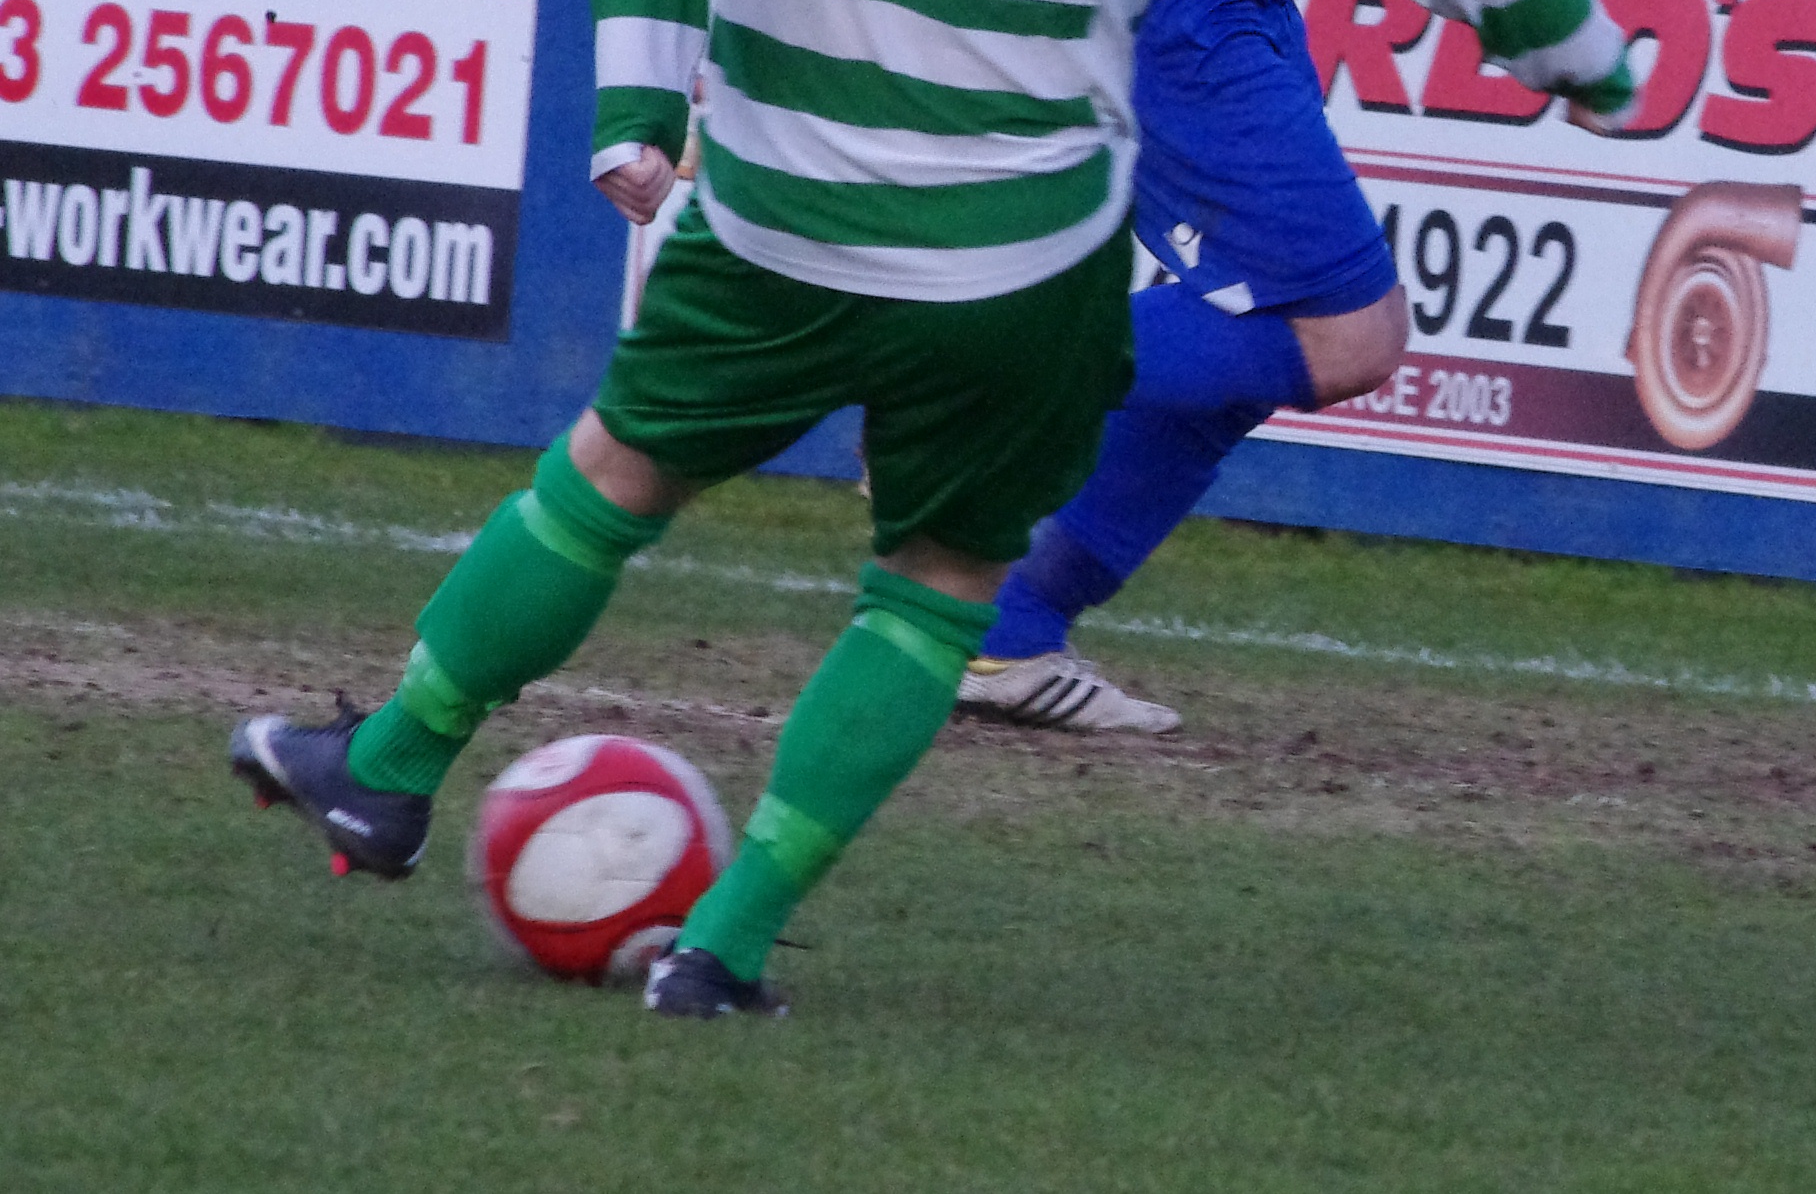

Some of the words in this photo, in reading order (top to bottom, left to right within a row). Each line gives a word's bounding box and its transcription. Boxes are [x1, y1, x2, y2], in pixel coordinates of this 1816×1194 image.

[76, 3, 488, 146] 2567021
[0, 165, 496, 306] workwear.com
[1424, 368, 1513, 427] 2003
